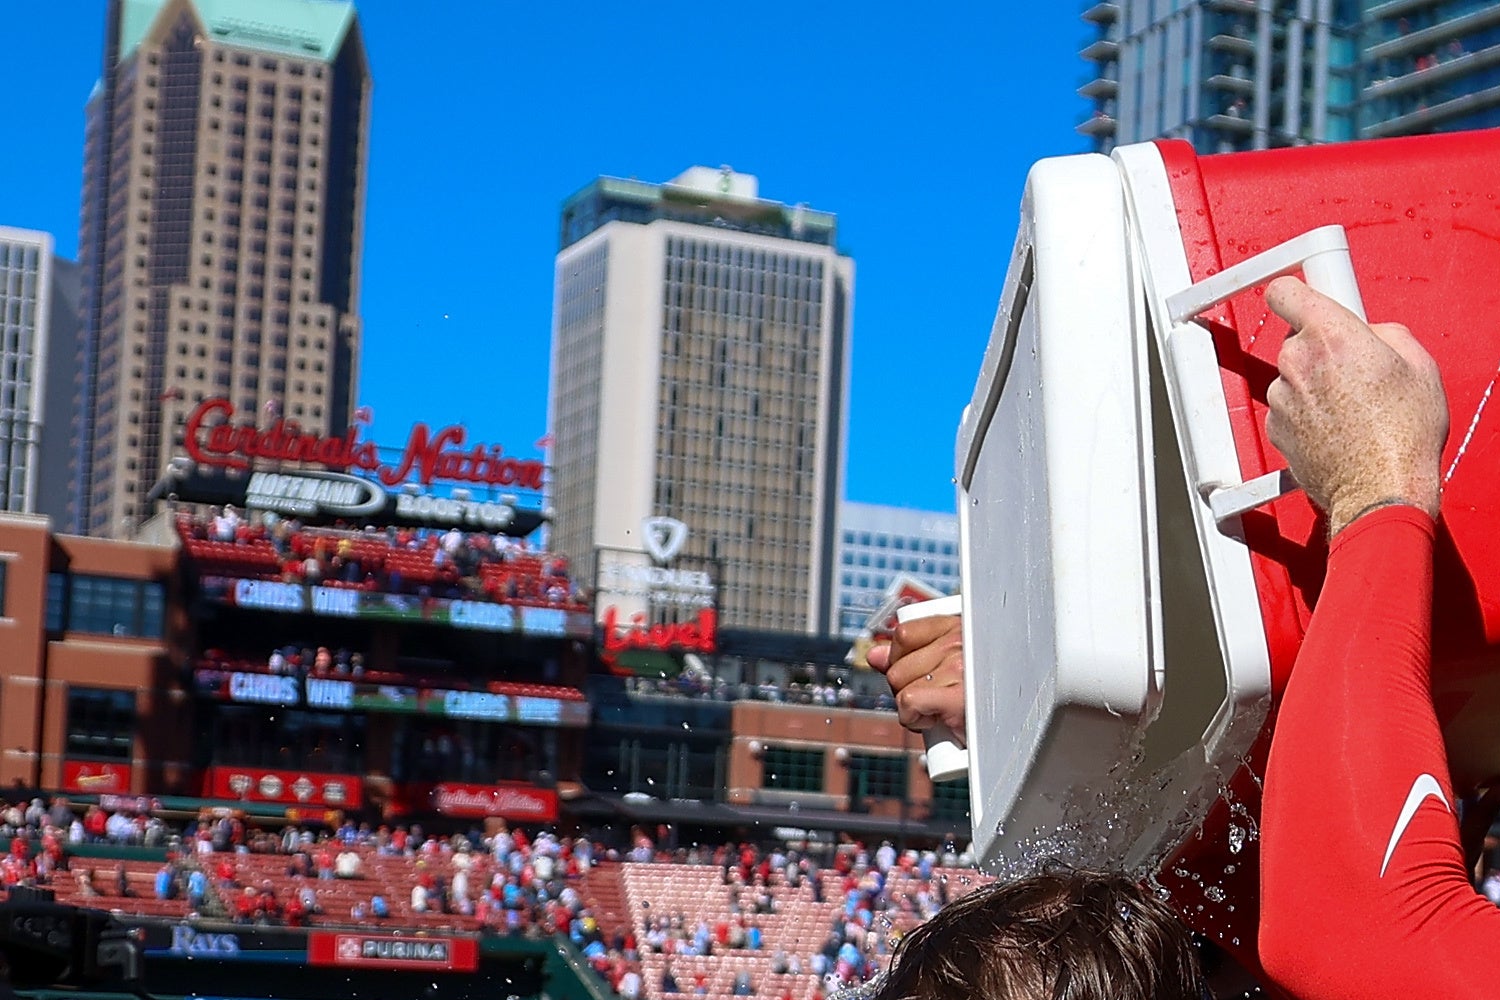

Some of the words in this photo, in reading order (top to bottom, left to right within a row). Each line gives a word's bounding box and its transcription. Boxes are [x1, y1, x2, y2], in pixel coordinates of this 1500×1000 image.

[185, 399, 379, 471] Cardinals
[380, 424, 543, 489] Nation
[363, 940, 448, 961] PURINA
